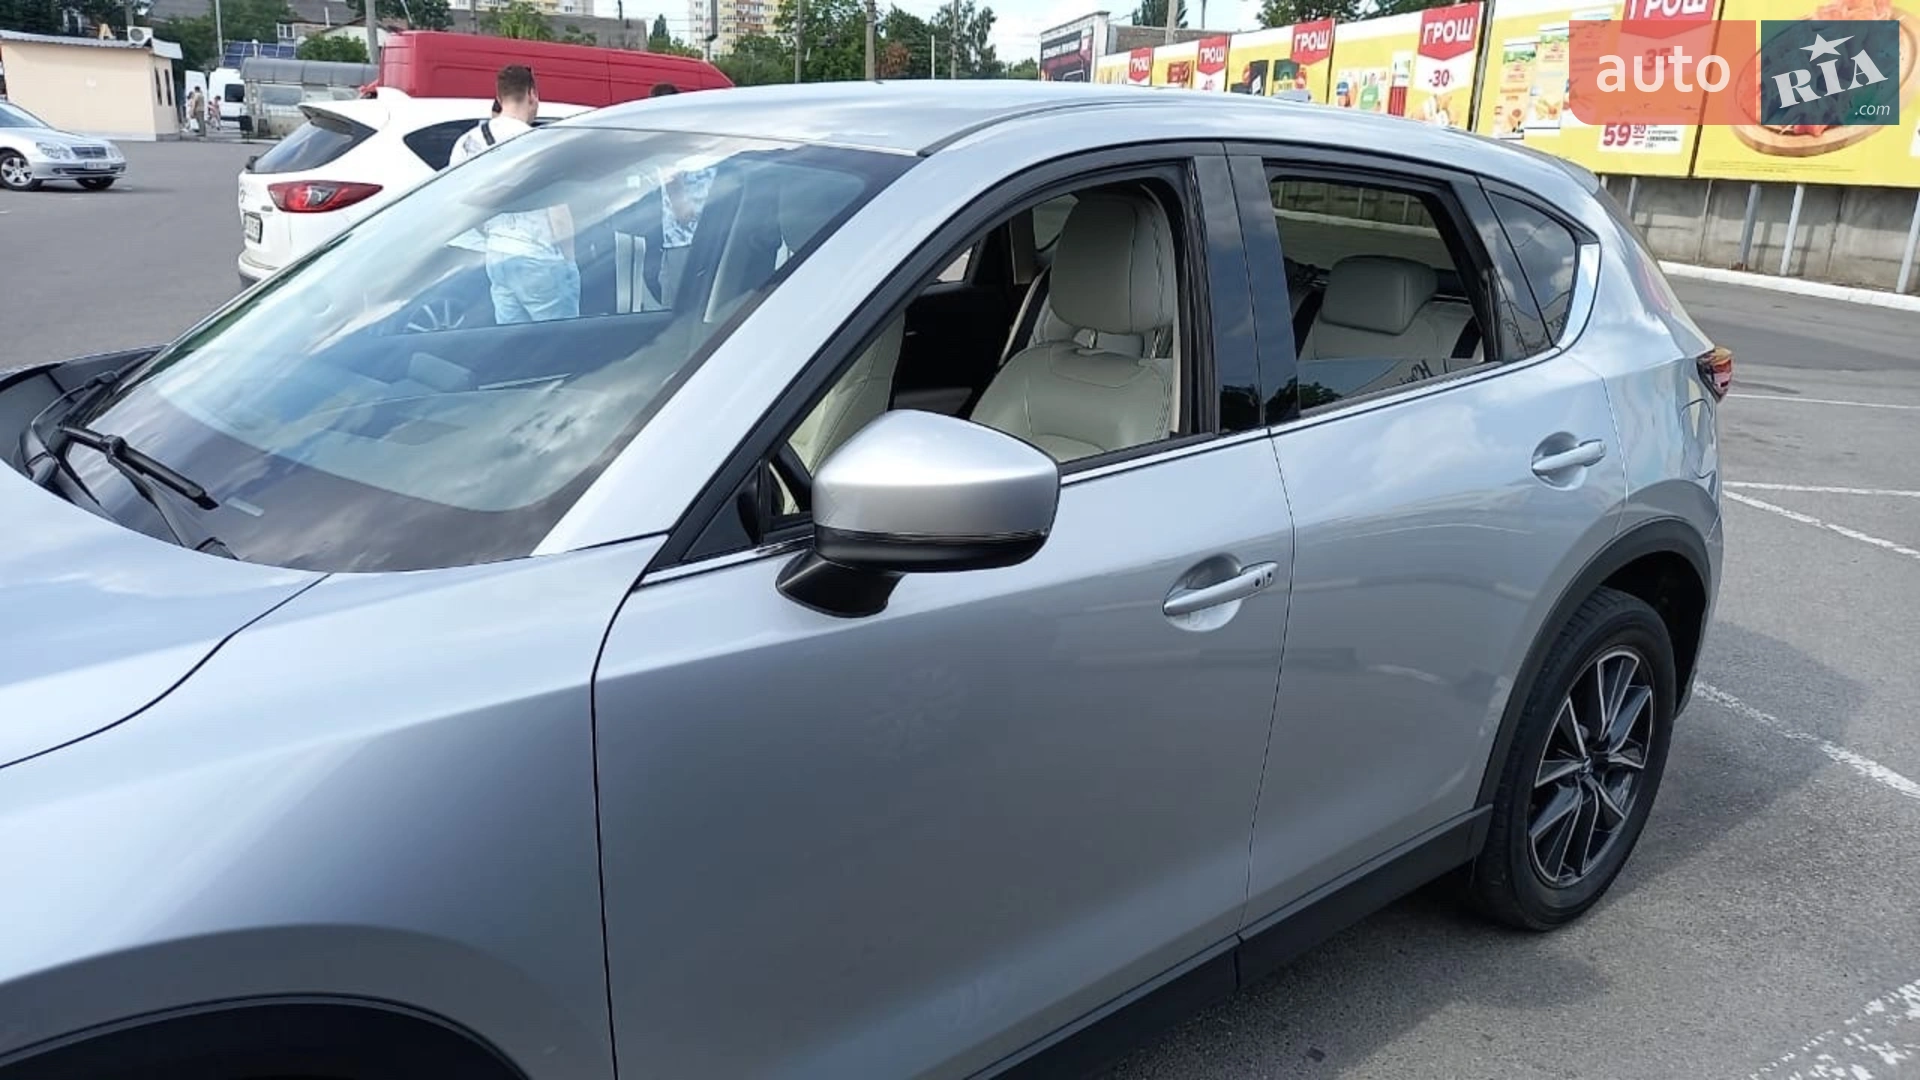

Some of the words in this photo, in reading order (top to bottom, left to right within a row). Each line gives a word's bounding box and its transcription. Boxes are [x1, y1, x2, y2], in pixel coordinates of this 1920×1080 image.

[1293, 30, 1331, 53] ГРОШ
[1422, 17, 1475, 45] ГРОШ
[1200, 47, 1225, 64] ГРОШ
[1603, 122, 1632, 146] 59
